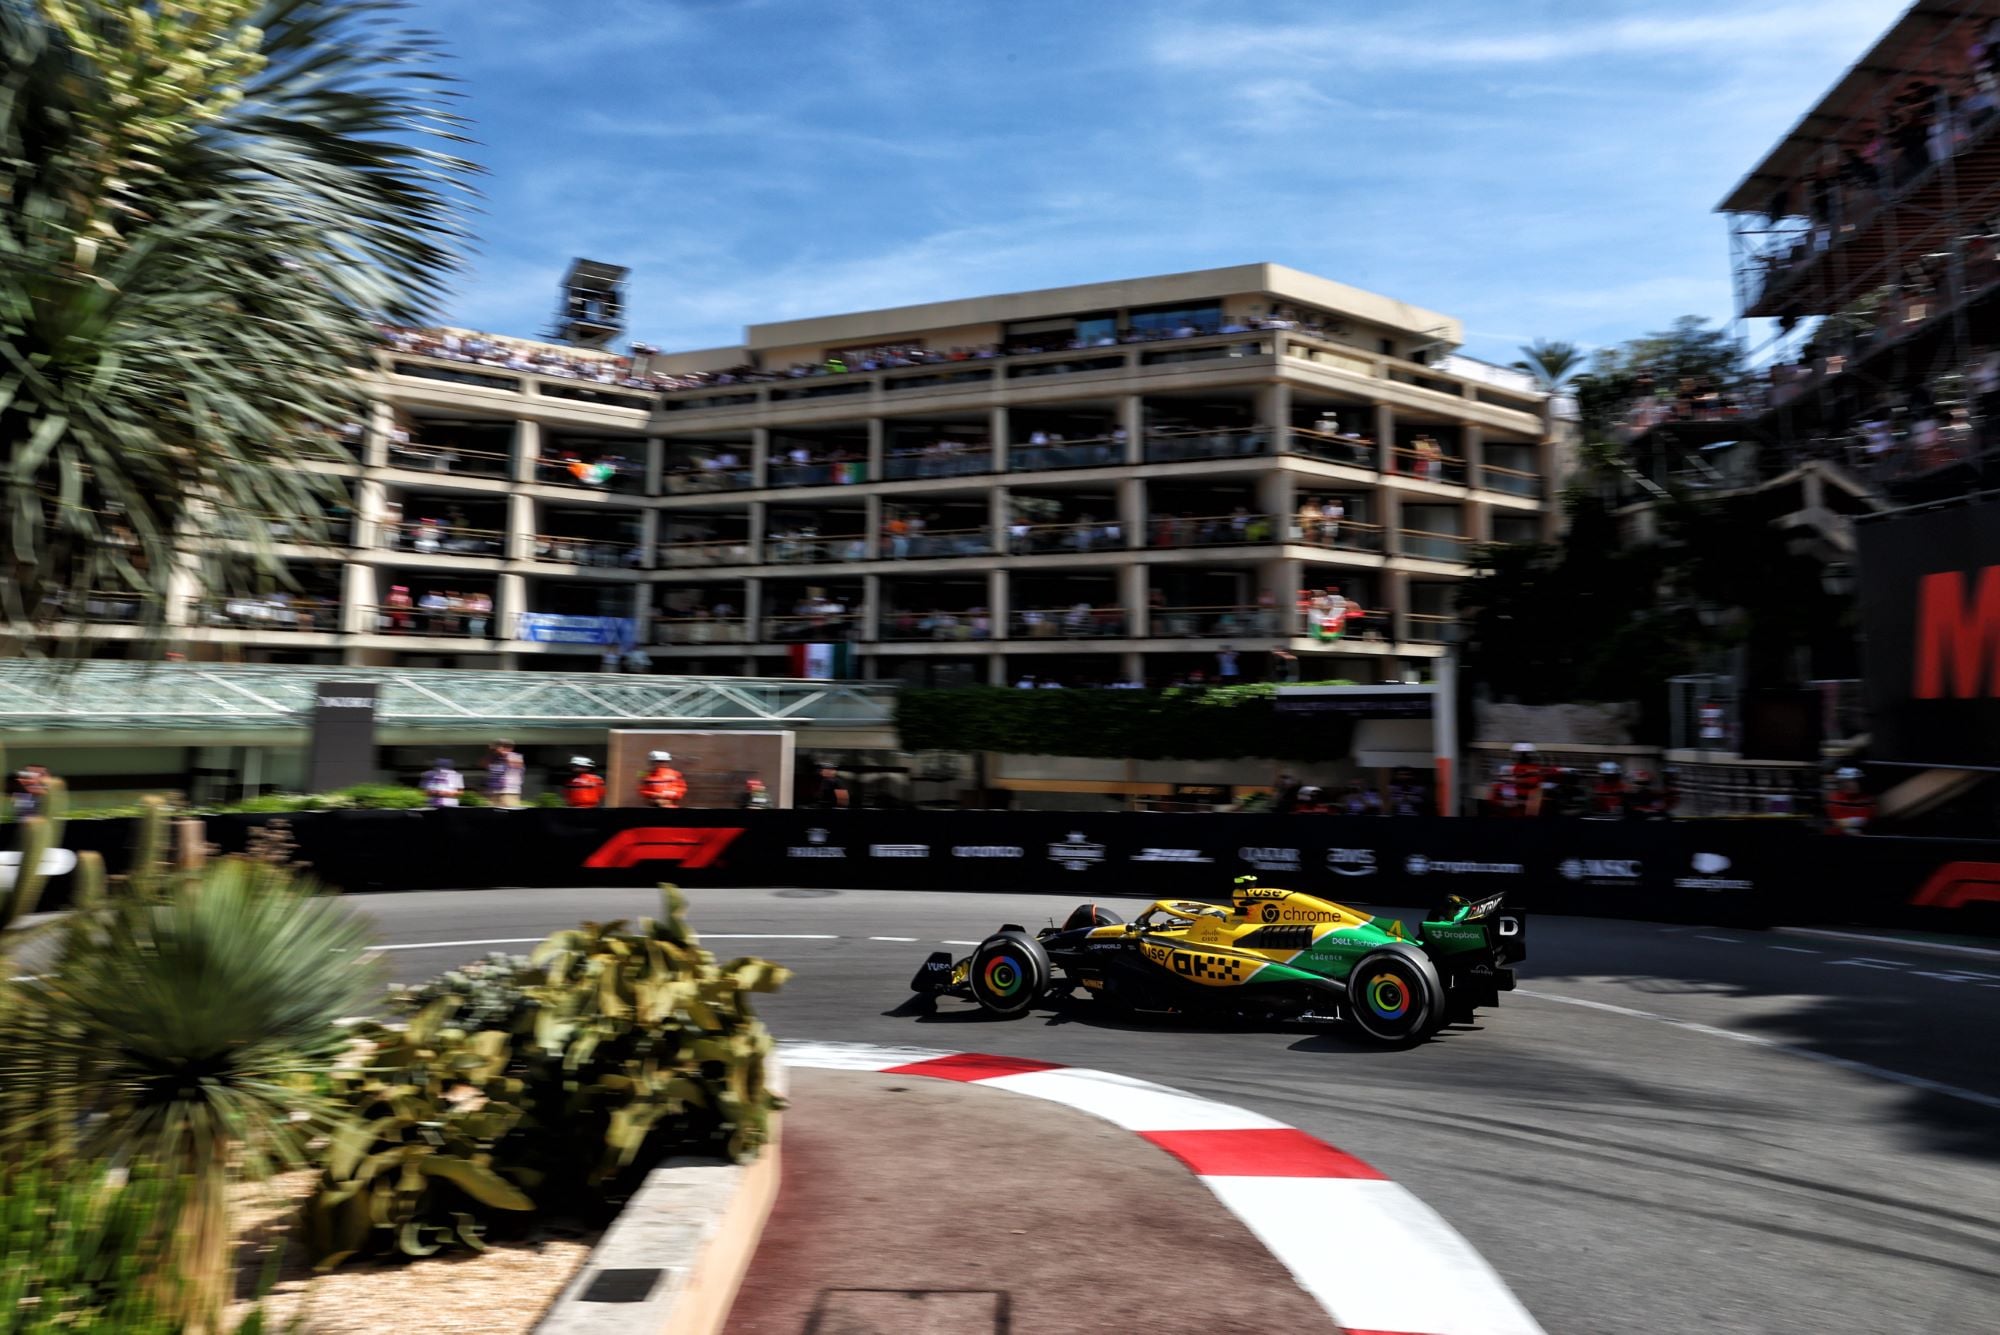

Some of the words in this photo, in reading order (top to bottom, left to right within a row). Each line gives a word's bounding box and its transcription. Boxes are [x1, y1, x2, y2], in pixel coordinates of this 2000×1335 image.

[582, 826, 746, 868] F1
[1283, 907, 1342, 922] chrome
[1444, 931, 1480, 940] Dropbox
